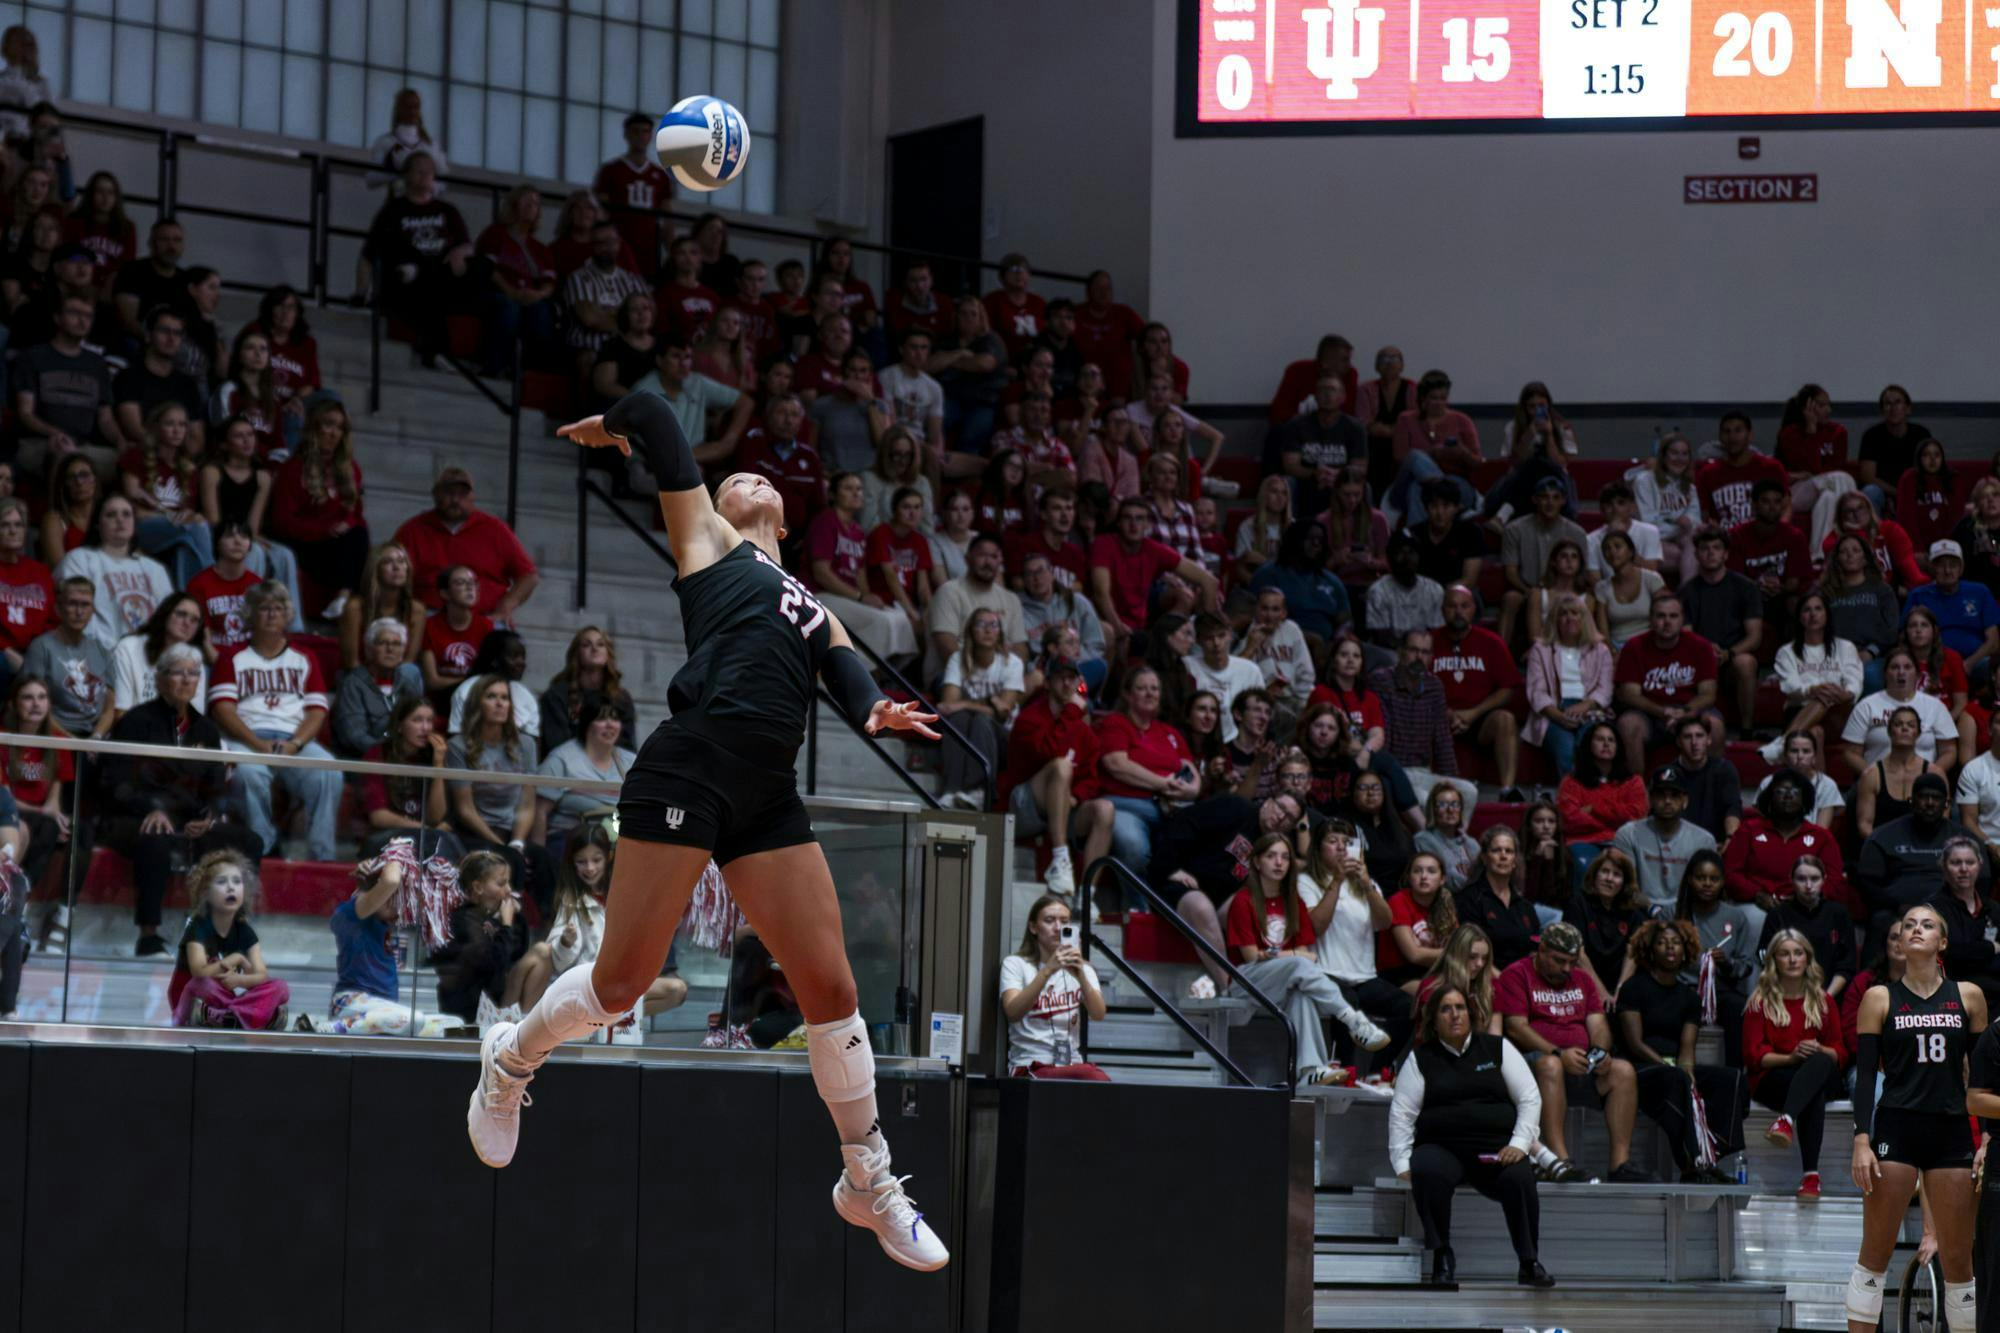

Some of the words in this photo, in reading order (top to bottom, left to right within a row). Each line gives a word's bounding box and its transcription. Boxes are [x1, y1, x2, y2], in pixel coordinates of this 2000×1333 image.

[1572, 0, 1628, 28] SET
[1639, 0, 1660, 26] 2
[1442, 18, 1511, 82] 15
[1712, 12, 1794, 77] 20
[1845, 0, 1942, 88] N
[1216, 54, 1253, 110] 0
[1583, 64, 1646, 95] 1:15
[711, 113, 723, 166] molten
[1688, 177, 1794, 201] SECTION
[1798, 177, 1815, 200] 2
[1711, 480, 1753, 509] HUR
[780, 579, 826, 640] 27
[1433, 656, 1486, 673] INDIANA
[239, 668, 304, 701] INDIAN
[1894, 1013, 1962, 1030] HOOSIERS
[1916, 1033, 1946, 1063] 18
